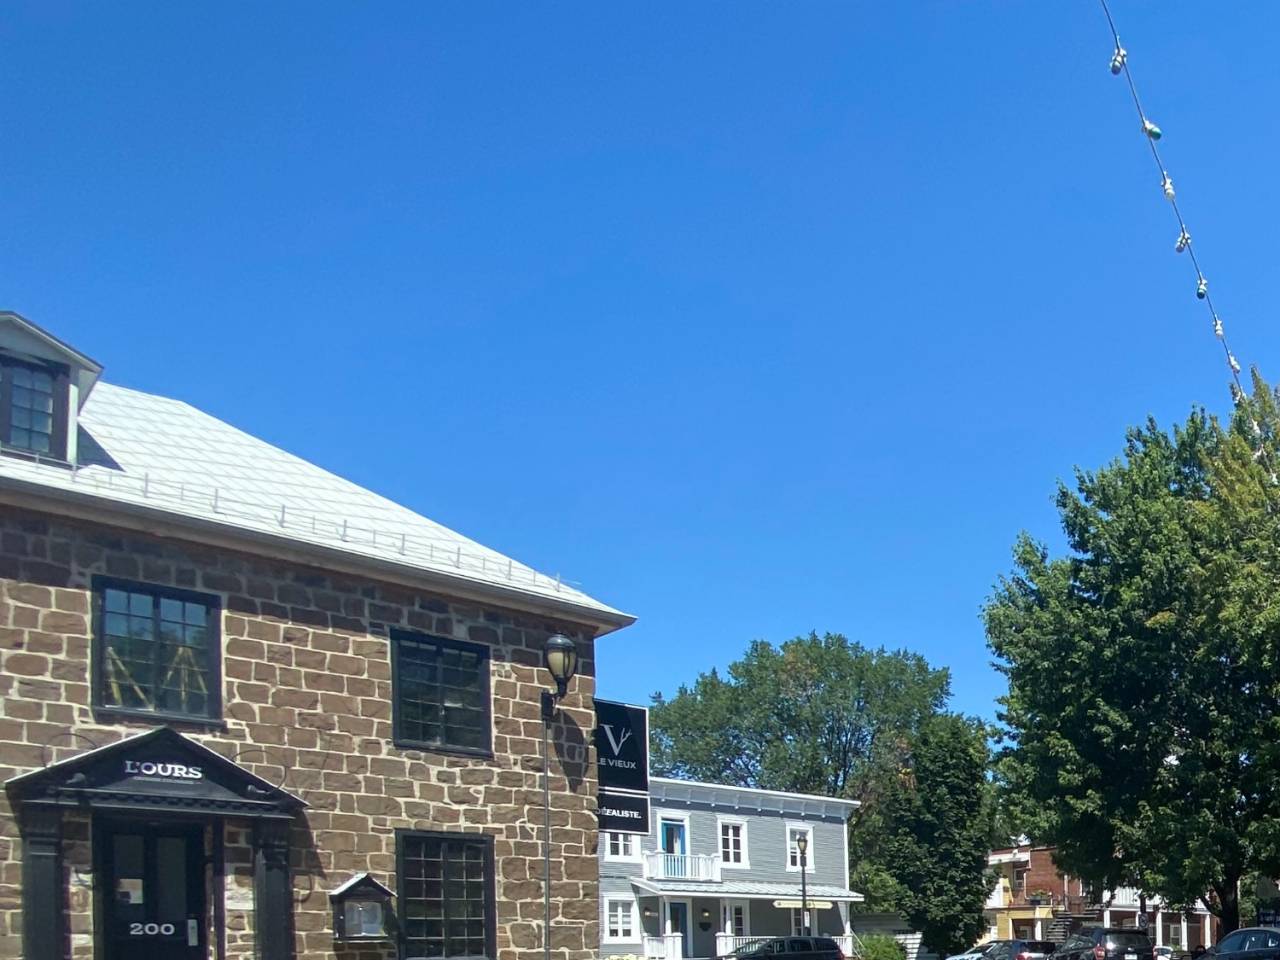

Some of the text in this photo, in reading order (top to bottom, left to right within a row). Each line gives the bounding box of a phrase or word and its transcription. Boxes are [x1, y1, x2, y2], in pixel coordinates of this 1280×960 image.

[125, 760, 203, 779] L'OURS
[608, 758, 637, 769] VIEUX
[130, 923, 175, 935] 200
